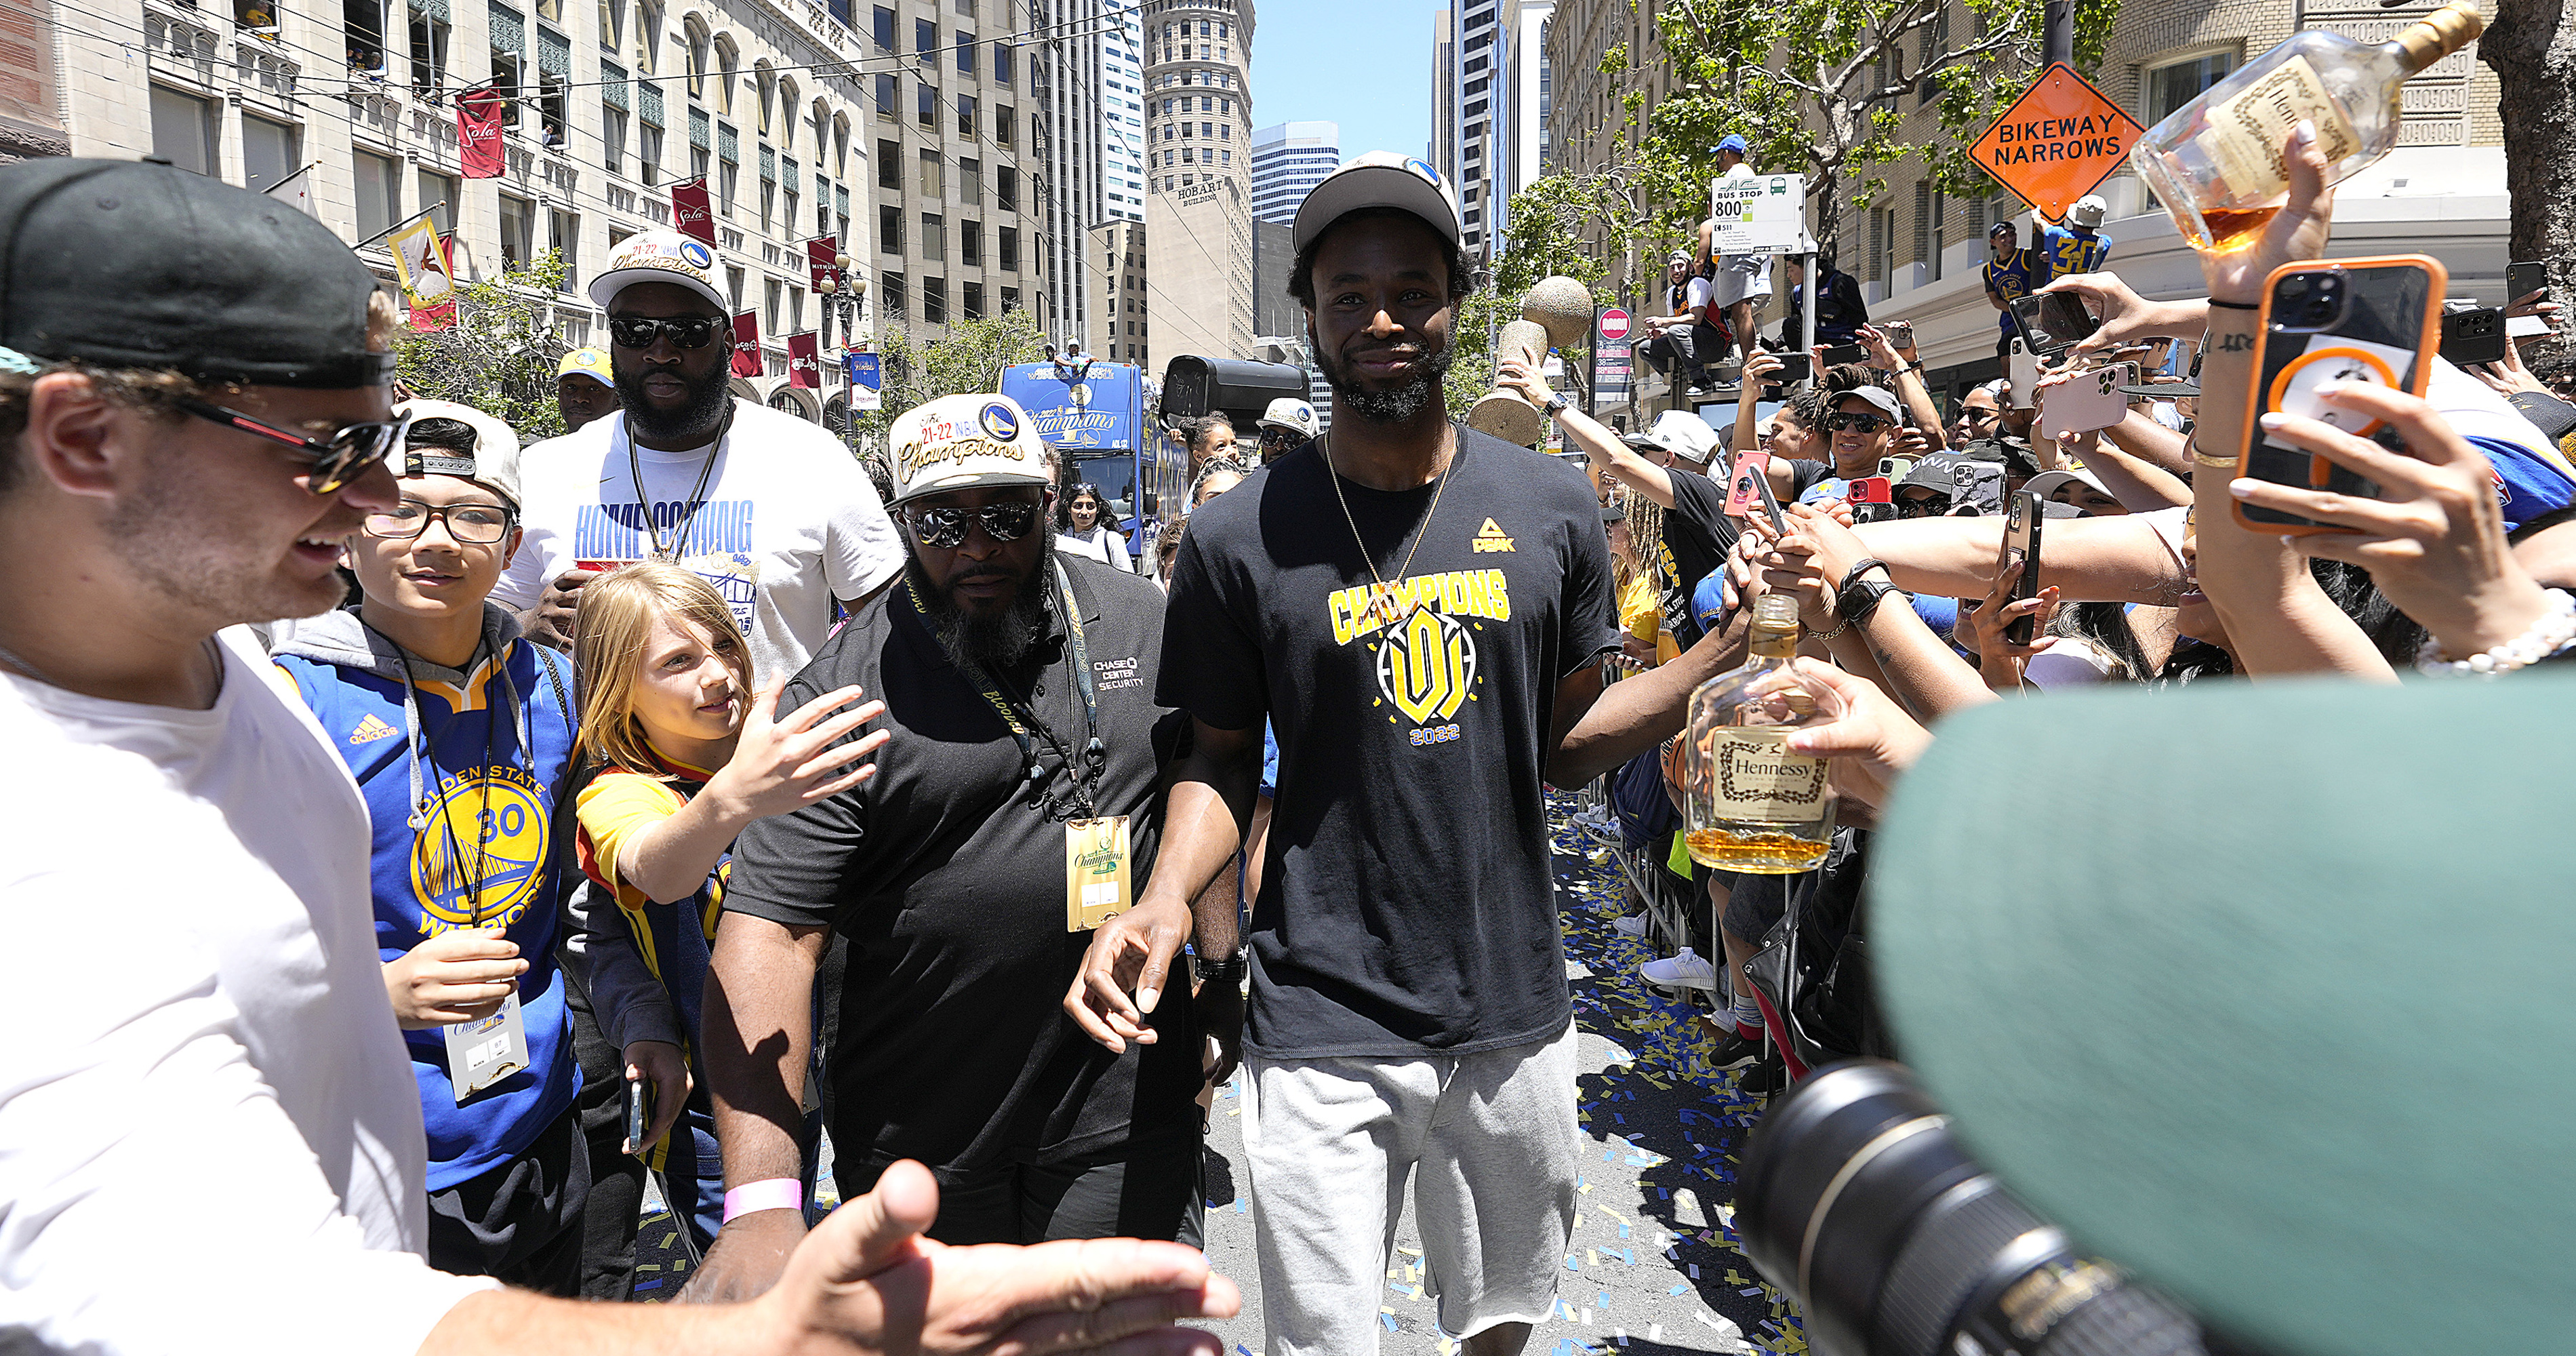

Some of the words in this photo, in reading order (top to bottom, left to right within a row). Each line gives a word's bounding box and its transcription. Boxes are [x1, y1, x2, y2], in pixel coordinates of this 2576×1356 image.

[462, 119, 498, 147] Sola
[2000, 113, 2116, 143] BIKEWAY
[1995, 136, 2120, 165] NARROWS
[1178, 180, 1222, 200] HOBART
[1183, 194, 1217, 207] BUILDING
[1716, 201, 1742, 216] 800
[679, 205, 708, 226] Sola
[632, 244, 657, 256] 21-22
[2007, 281, 2017, 289] 30
[1597, 358, 1606, 366] 38
[922, 422, 952, 445] 21-22
[954, 420, 979, 437] NBA
[898, 436, 1024, 485] Champions
[1472, 538, 1516, 553] PEAK
[1093, 660, 1126, 671] CHASE
[1102, 669, 1135, 680] CENTER
[1098, 678, 1144, 691] SECURITY
[982, 690, 1025, 734] BLOODED
[349, 726, 399, 744] adidas
[1409, 723, 1460, 746] 2022
[1736, 759, 1813, 778] Hennessy
[489, 765, 547, 798] STATE
[475, 803, 525, 844] 30
[1074, 852, 1124, 869] Champions
[495, 1040, 502, 1048] 87
